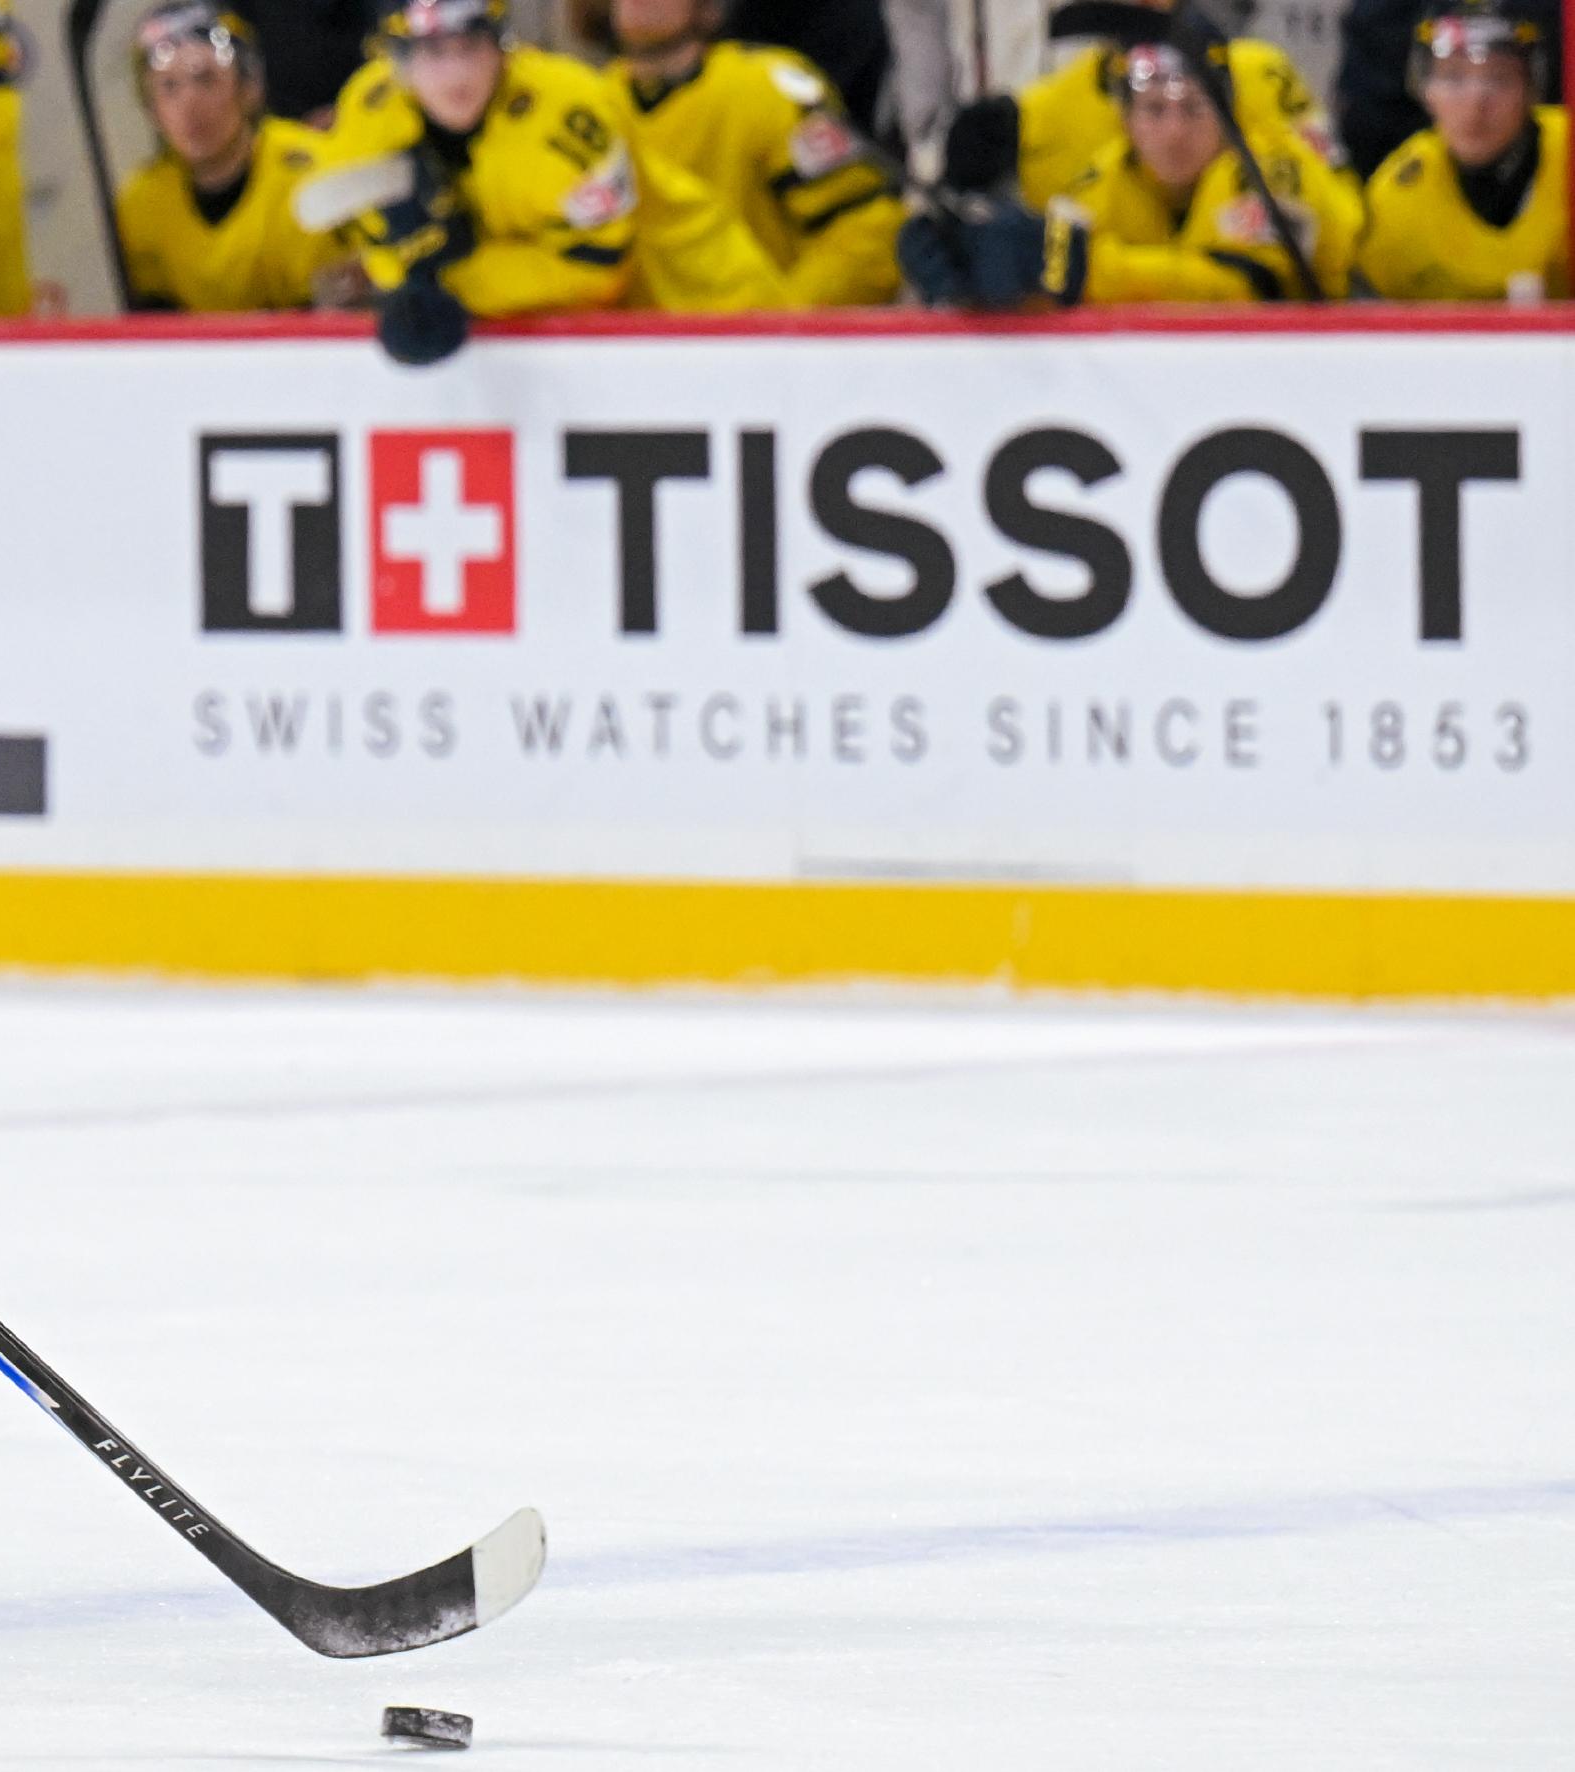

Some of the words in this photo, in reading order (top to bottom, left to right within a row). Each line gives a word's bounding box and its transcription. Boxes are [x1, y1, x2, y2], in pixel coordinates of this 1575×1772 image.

[561, 425, 1521, 642] TISSOT
[194, 692, 456, 758] SWISS
[509, 692, 928, 764] WATCHES
[985, 696, 1258, 766] SINCE
[1323, 698, 1531, 772] 1853
[94, 1438, 210, 1538] FLYLITE
